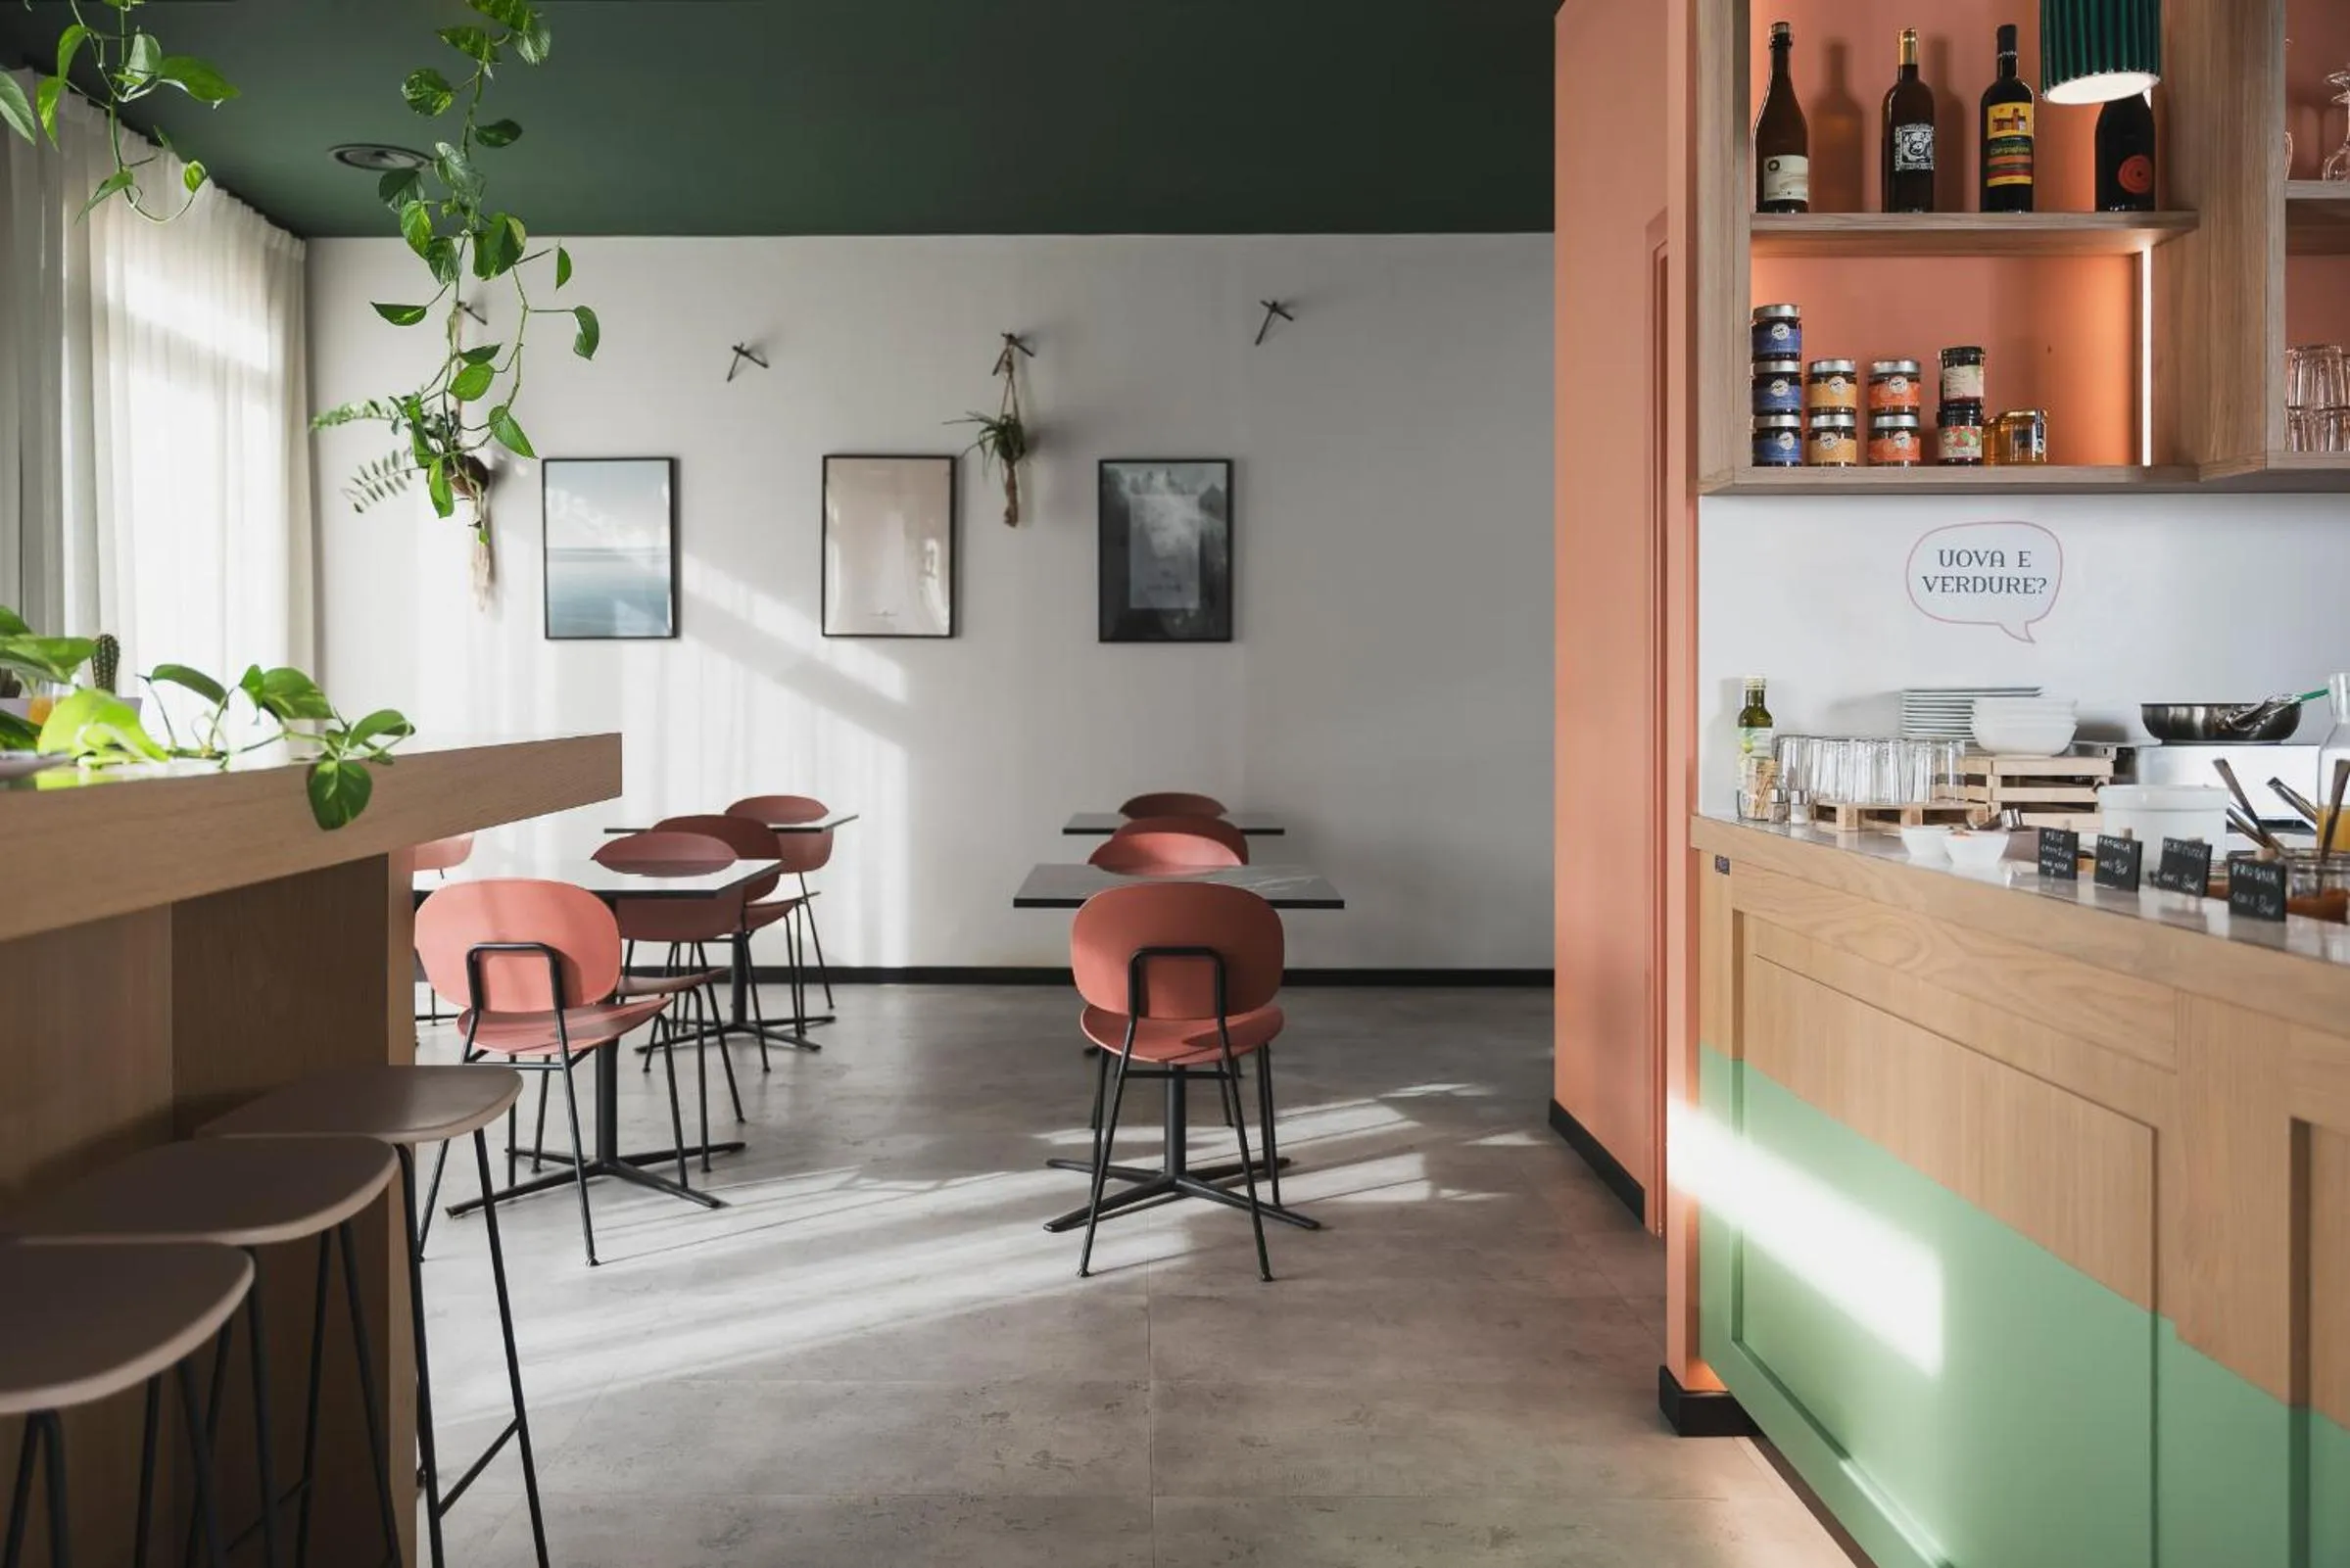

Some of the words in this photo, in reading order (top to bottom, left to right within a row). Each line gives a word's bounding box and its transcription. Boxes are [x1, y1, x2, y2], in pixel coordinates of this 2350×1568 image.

[1938, 548, 2005, 568] UOVA
[2017, 550, 2032, 568] E
[1921, 575, 2047, 594] VERDURE?
